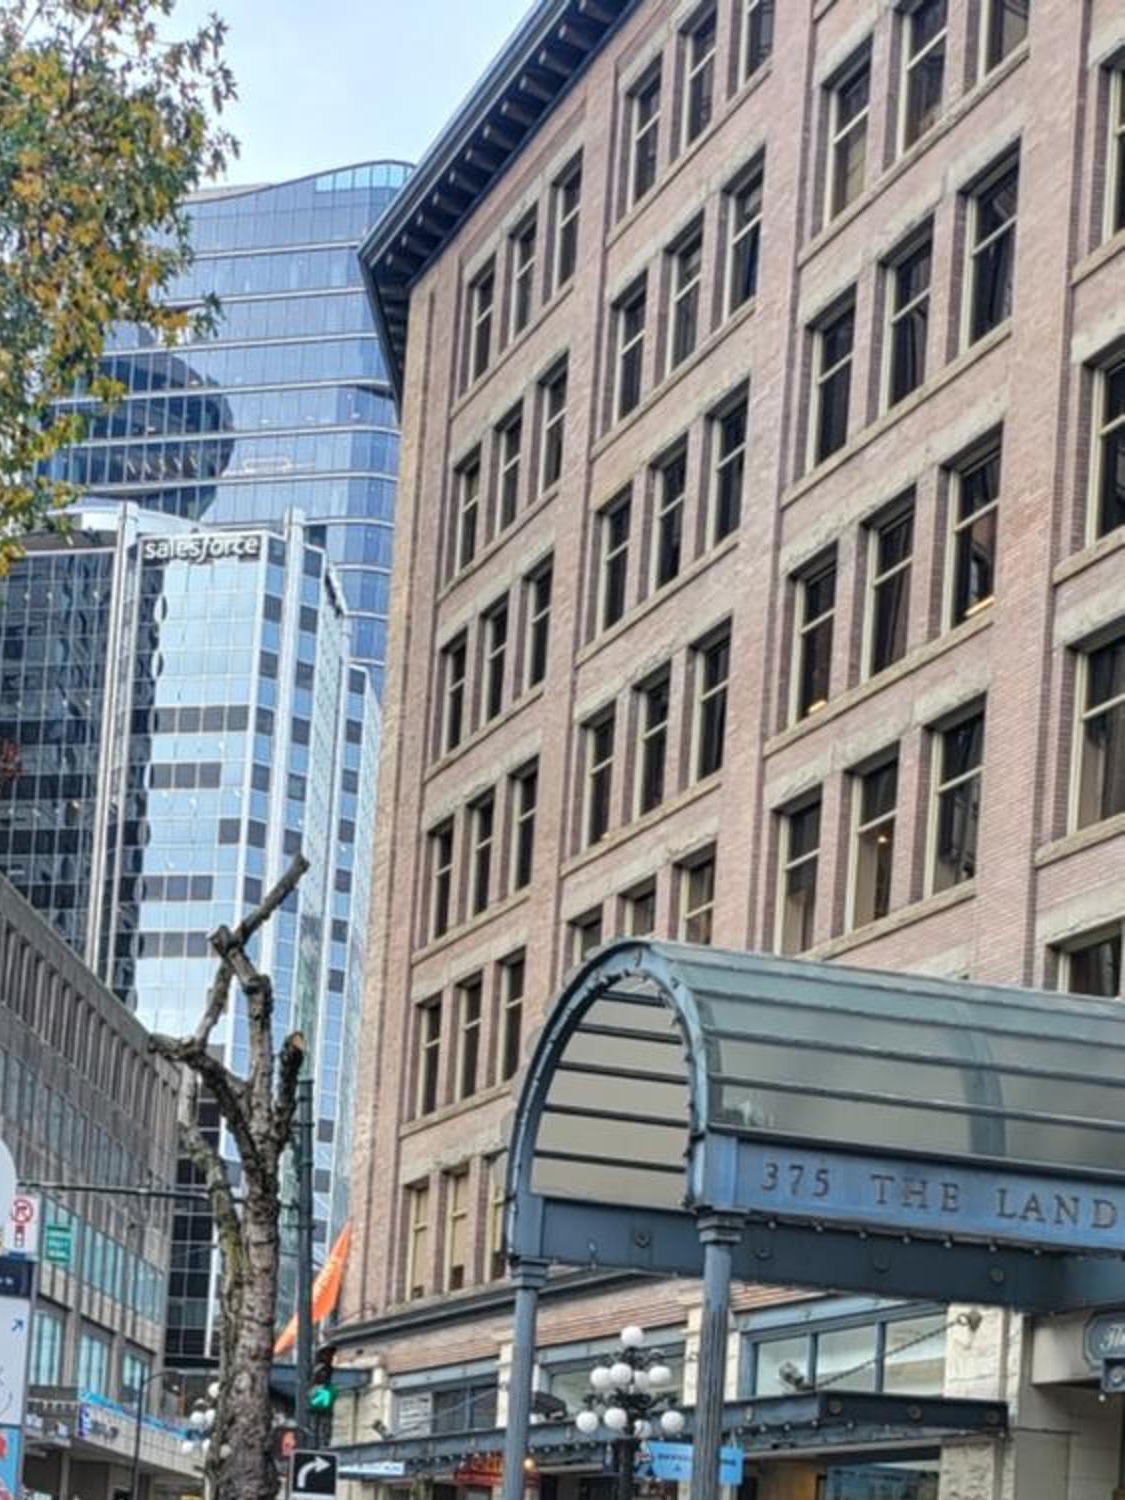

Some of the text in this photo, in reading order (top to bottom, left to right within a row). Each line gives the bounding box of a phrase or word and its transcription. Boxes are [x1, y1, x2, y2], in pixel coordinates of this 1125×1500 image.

[144, 537, 259, 563] salesforce
[759, 1161, 1118, 1230] 375 THE LAND
